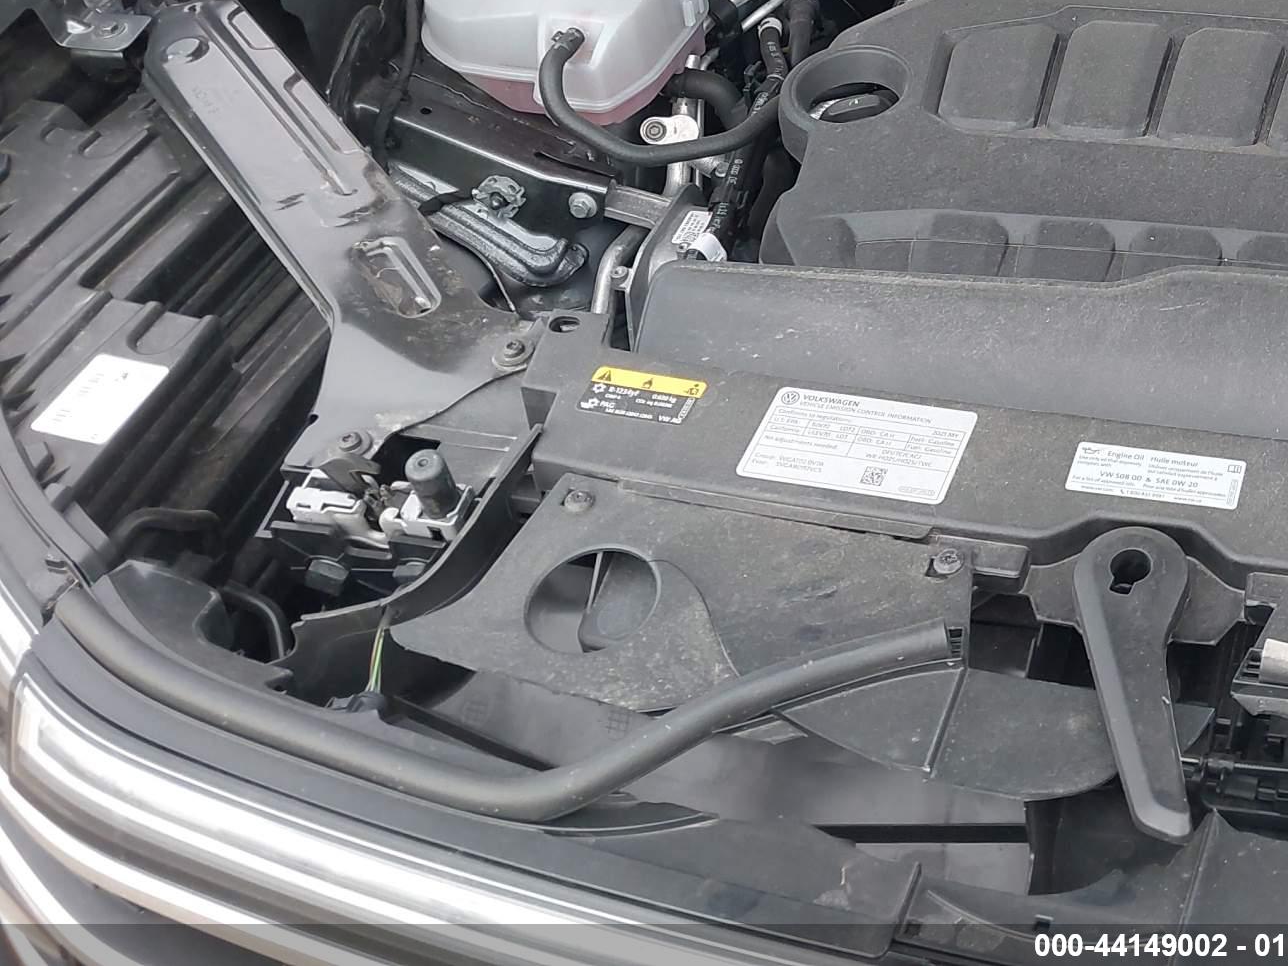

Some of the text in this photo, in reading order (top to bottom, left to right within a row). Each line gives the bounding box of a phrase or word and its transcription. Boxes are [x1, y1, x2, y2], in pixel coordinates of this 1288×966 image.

[801, 393, 860, 407] VOLKSWAGEN
[856, 408, 885, 416] CONTROL
[886, 412, 932, 423] INFORMATION
[1106, 450, 1133, 460] Engine
[1170, 458, 1198, 467] moteur
